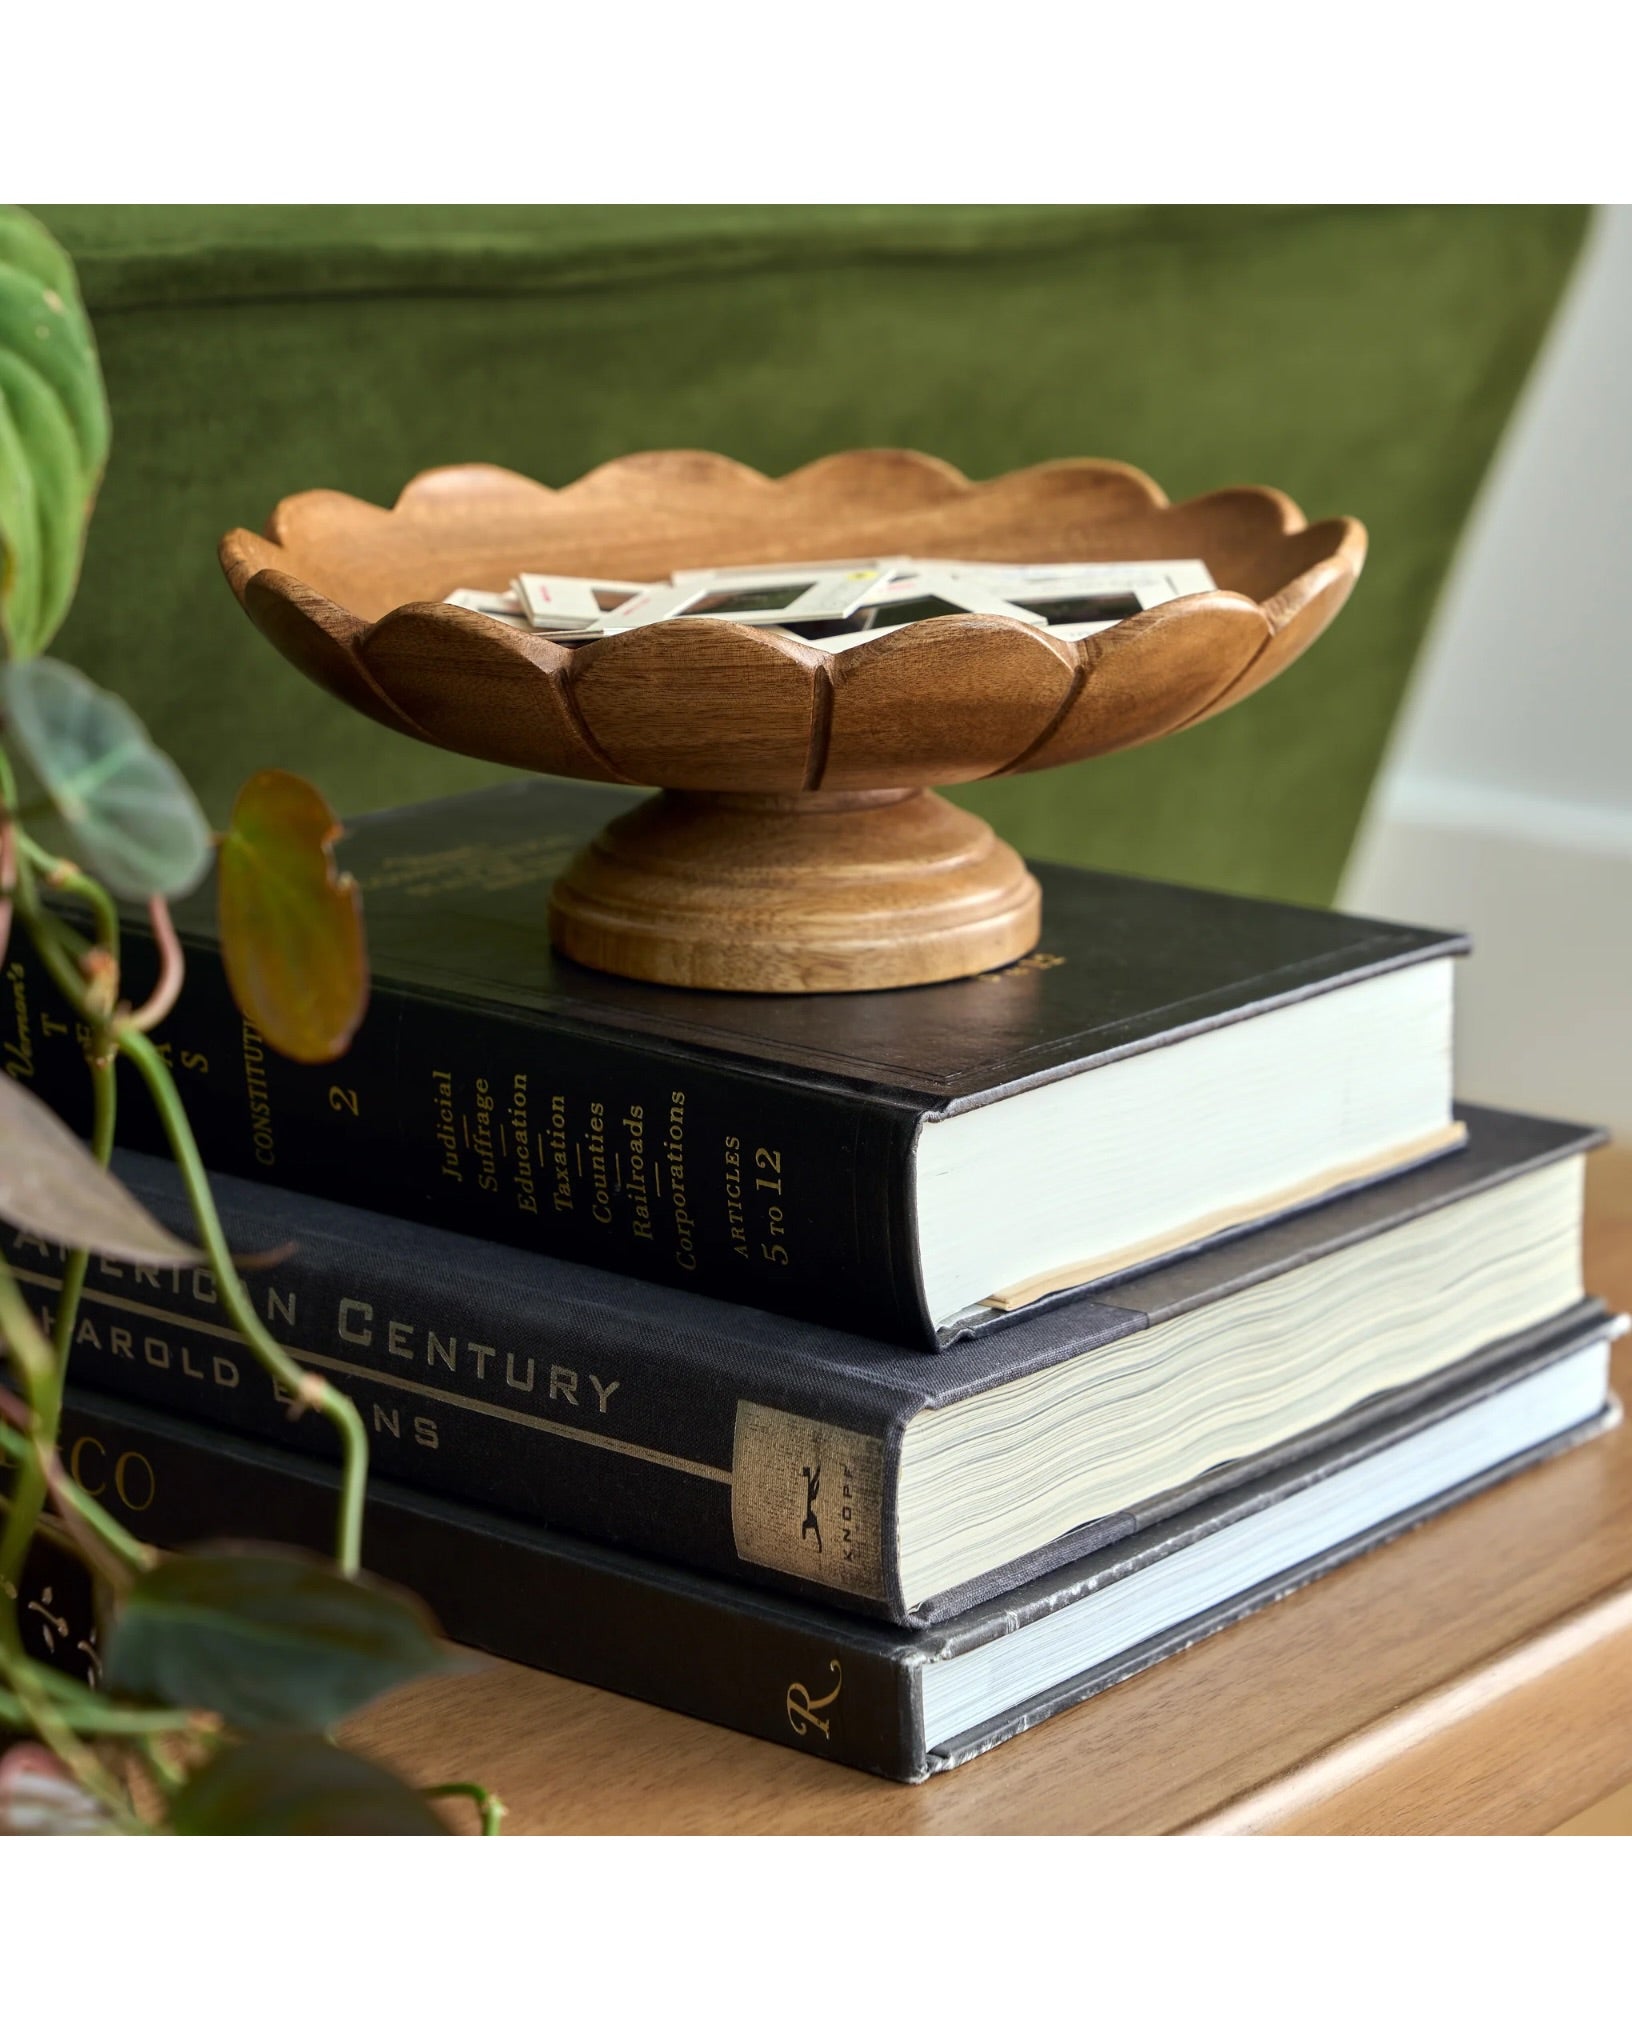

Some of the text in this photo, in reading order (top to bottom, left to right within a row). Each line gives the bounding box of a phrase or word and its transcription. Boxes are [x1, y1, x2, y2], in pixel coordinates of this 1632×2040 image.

[329, 1086, 359, 1116] 2
[433, 1070, 463, 1182] Judicial
[471, 1077, 498, 1191] Suffrage
[508, 1073, 538, 1214] Education
[546, 1096, 574, 1211] Taxation
[585, 1102, 612, 1224] Counties
[623, 1104, 653, 1239] Railroads
[664, 1091, 697, 1271] Corporations
[725, 1136, 749, 1259] ARTICLES
[756, 1147, 782, 1196] 12
[763, 1242, 788, 1266] 5
[272, 1373, 439, 1449] ENS
[338, 1297, 620, 1413] CENTURY
[841, 1463, 853, 1561] KNOPF
[786, 1659, 842, 1741] R
